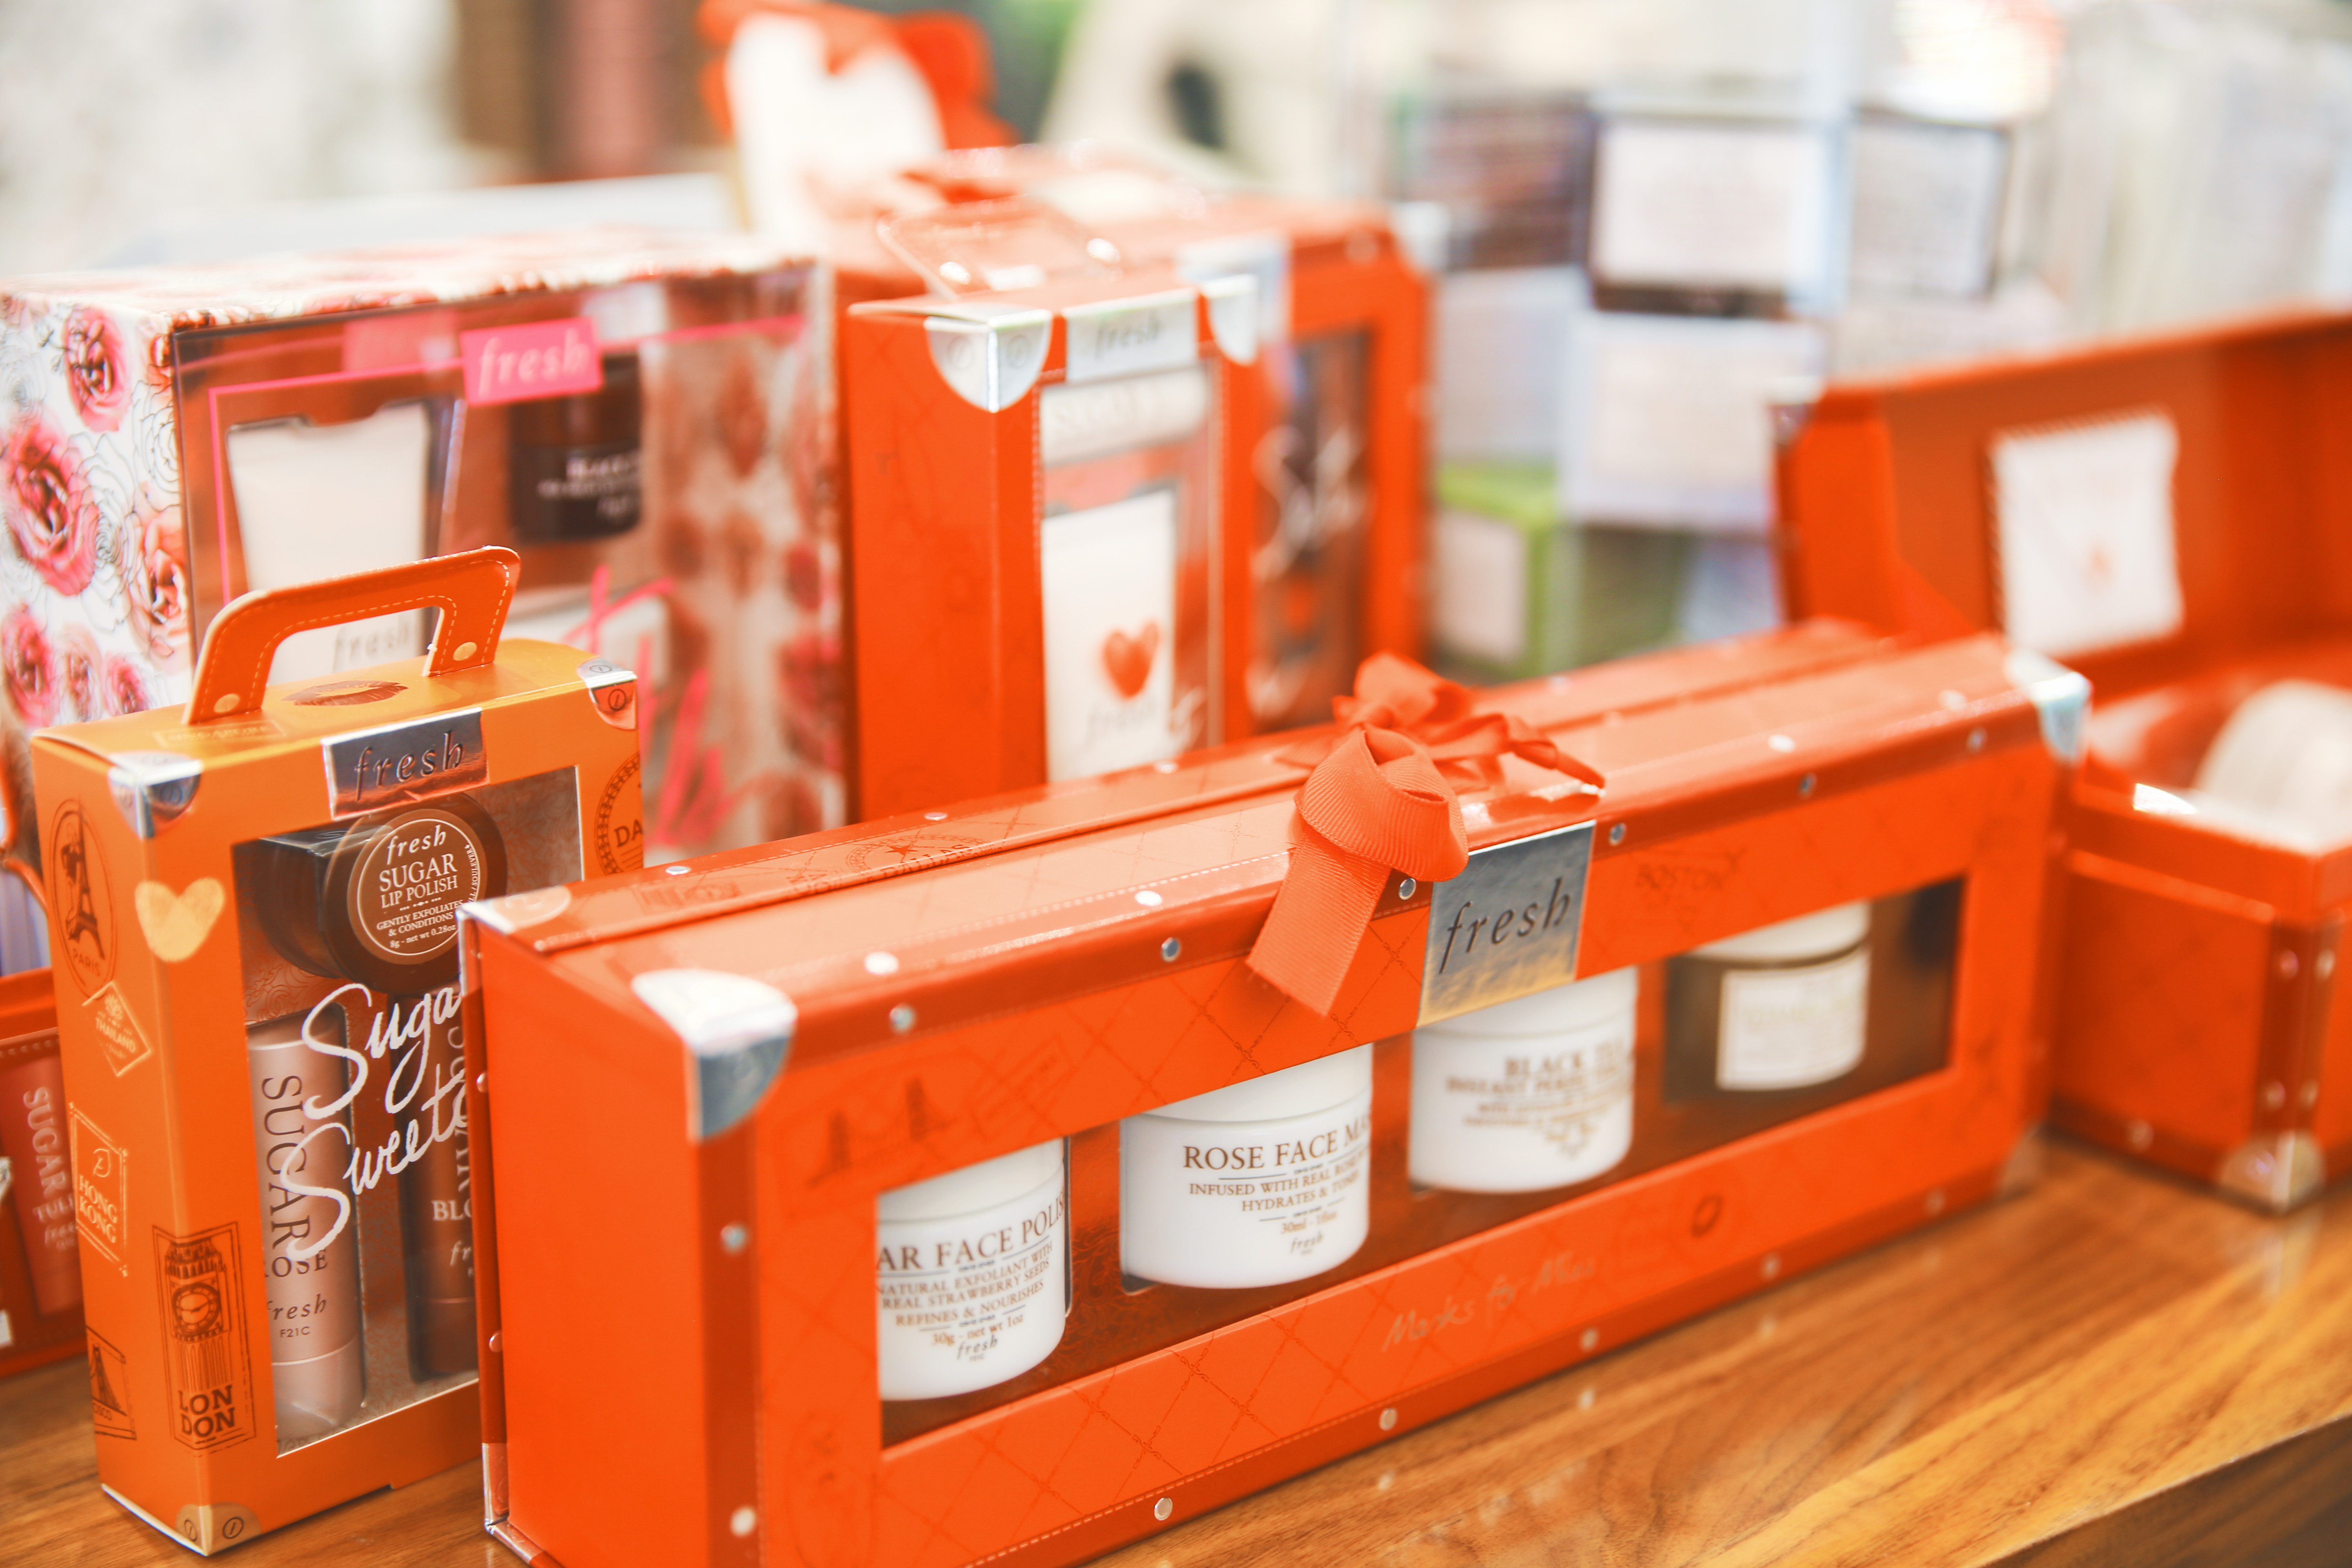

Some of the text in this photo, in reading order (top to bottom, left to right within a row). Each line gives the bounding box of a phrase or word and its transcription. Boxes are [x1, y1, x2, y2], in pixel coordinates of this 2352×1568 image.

[478, 334, 591, 397] fresh
[354, 730, 464, 801] fresh
[386, 824, 447, 865] fresh
[379, 853, 458, 892] SUGAR
[380, 875, 458, 909] LIP POLISH
[376, 899, 463, 930] GENTLY EXFOLIATES
[388, 911, 454, 936] & CONDITIONS
[1438, 876, 1573, 975] fresh
[390, 940, 400, 948] 8g
[430, 924, 457, 935] 0.28oz
[72, 948, 101, 977] PARIS
[95, 1017, 137, 1054] THAILAND
[23, 1086, 67, 1200] SUGAR
[261, 1075, 313, 1250] SUGAR
[279, 1063, 470, 1262] Sweet
[1183, 1145, 1265, 1171] ROSE
[1274, 1129, 1339, 1167] FACE
[79, 1173, 118, 1224] HONG
[1189, 1183, 1255, 1196] INFUSED
[1259, 1176, 1299, 1194] WITH
[1302, 1169, 1331, 1187] REAL
[1242, 1190, 1316, 1212] HYDRATES
[79, 1195, 117, 1244] KONG
[935, 1226, 1013, 1268] FACE
[1022, 1190, 1065, 1245] POLIS
[1290, 1230, 1324, 1255] fresh
[265, 1247, 328, 1278] OSE
[955, 1255, 1028, 1290] EXFOLIANT
[1031, 1241, 1052, 1263] WITH
[882, 1258, 1049, 1310] REAL STRAWBERRY SEEDS
[896, 1310, 959, 1327] REFINES
[980, 1279, 1044, 1315] NOURISHES
[280, 1325, 310, 1338] F21C
[957, 1334, 999, 1361] fresh
[178, 1383, 233, 1417] LON
[180, 1406, 236, 1439] DON
